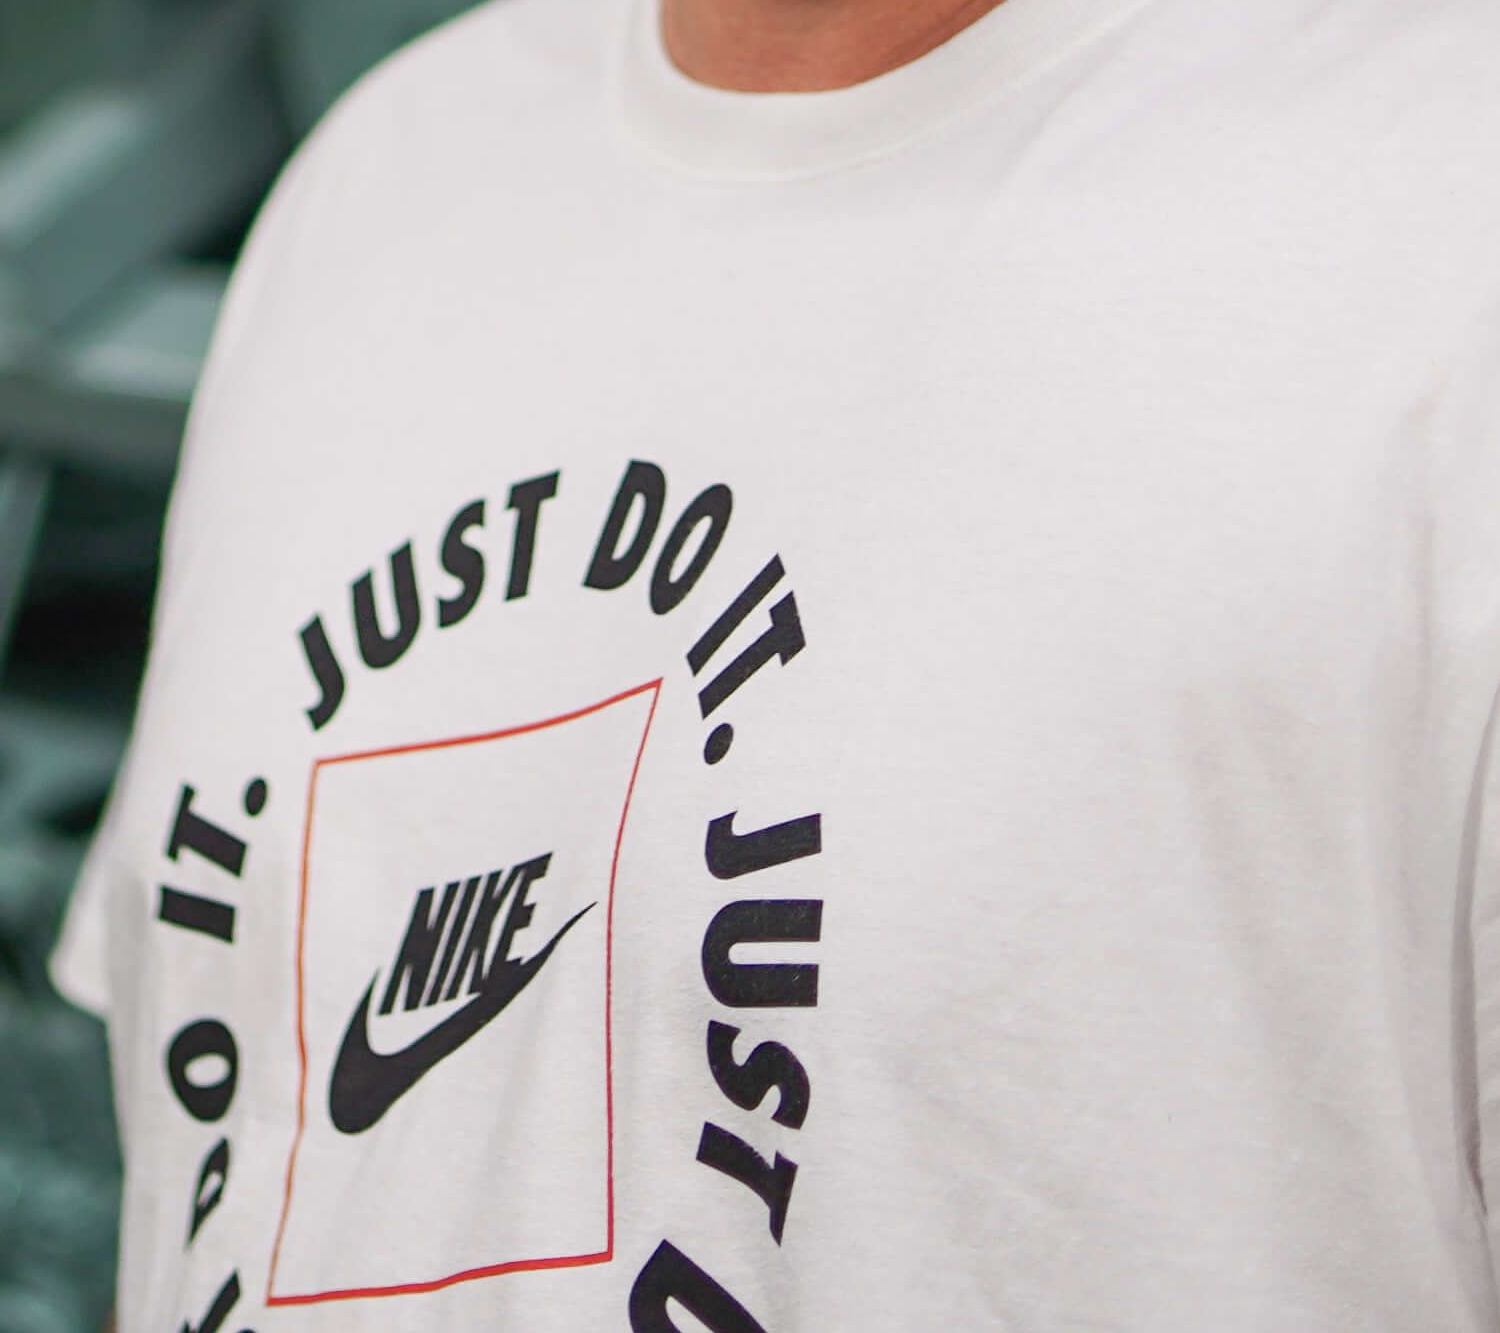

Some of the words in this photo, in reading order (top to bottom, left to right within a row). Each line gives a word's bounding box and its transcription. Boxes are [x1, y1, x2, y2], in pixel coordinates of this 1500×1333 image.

[298, 468, 561, 732] JUST
[583, 458, 733, 616] DO
[685, 553, 807, 766] IT.
[156, 776, 268, 944] IT.
[377, 851, 555, 1016] NIKE
[694, 810, 824, 1248] JUST
